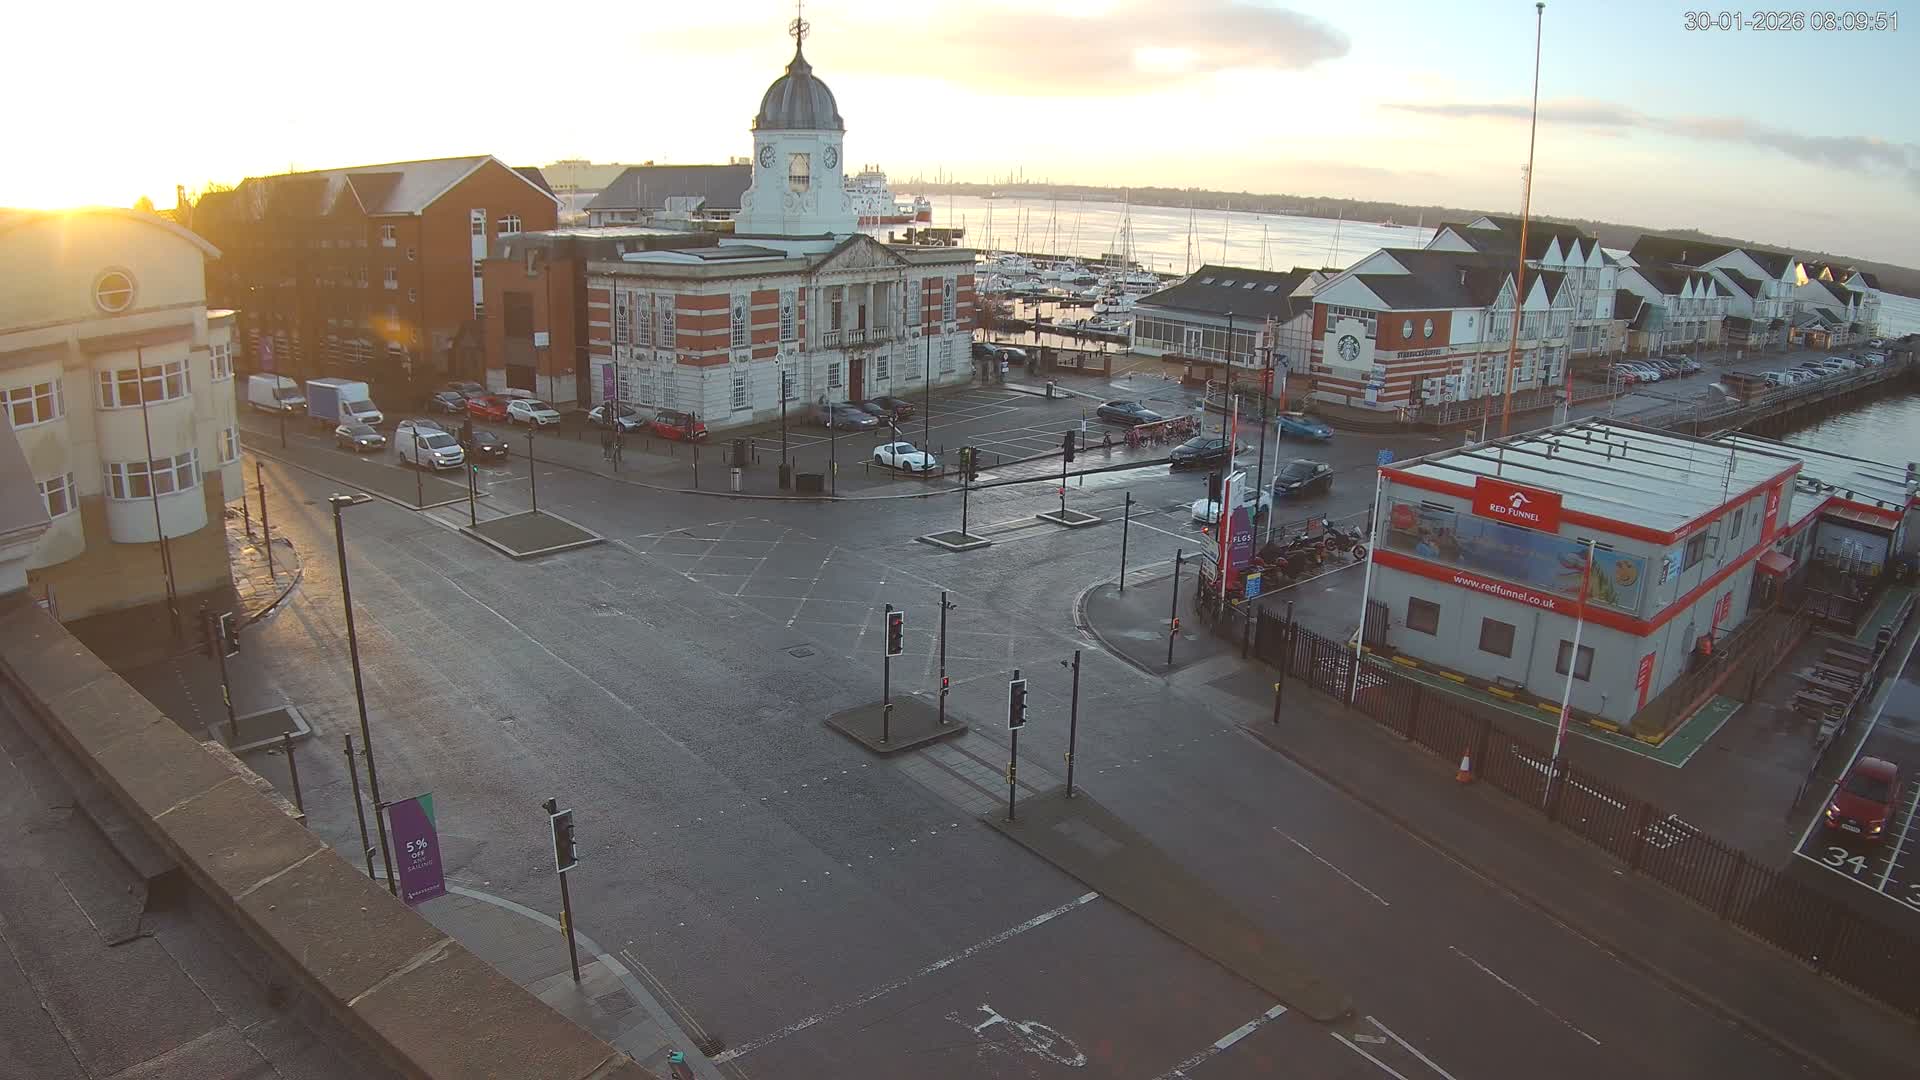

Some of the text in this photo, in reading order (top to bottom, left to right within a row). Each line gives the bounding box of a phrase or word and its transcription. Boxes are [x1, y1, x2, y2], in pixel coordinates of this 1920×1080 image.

[1490, 503, 1540, 522] RED FUNNEL
[1453, 575, 1555, 609] www.redfunnel.co.uk
[411, 850, 425, 859] OFF
[413, 856, 426, 864] ANY
[1821, 846, 1868, 875] 34
[407, 859, 433, 873] SAILING
